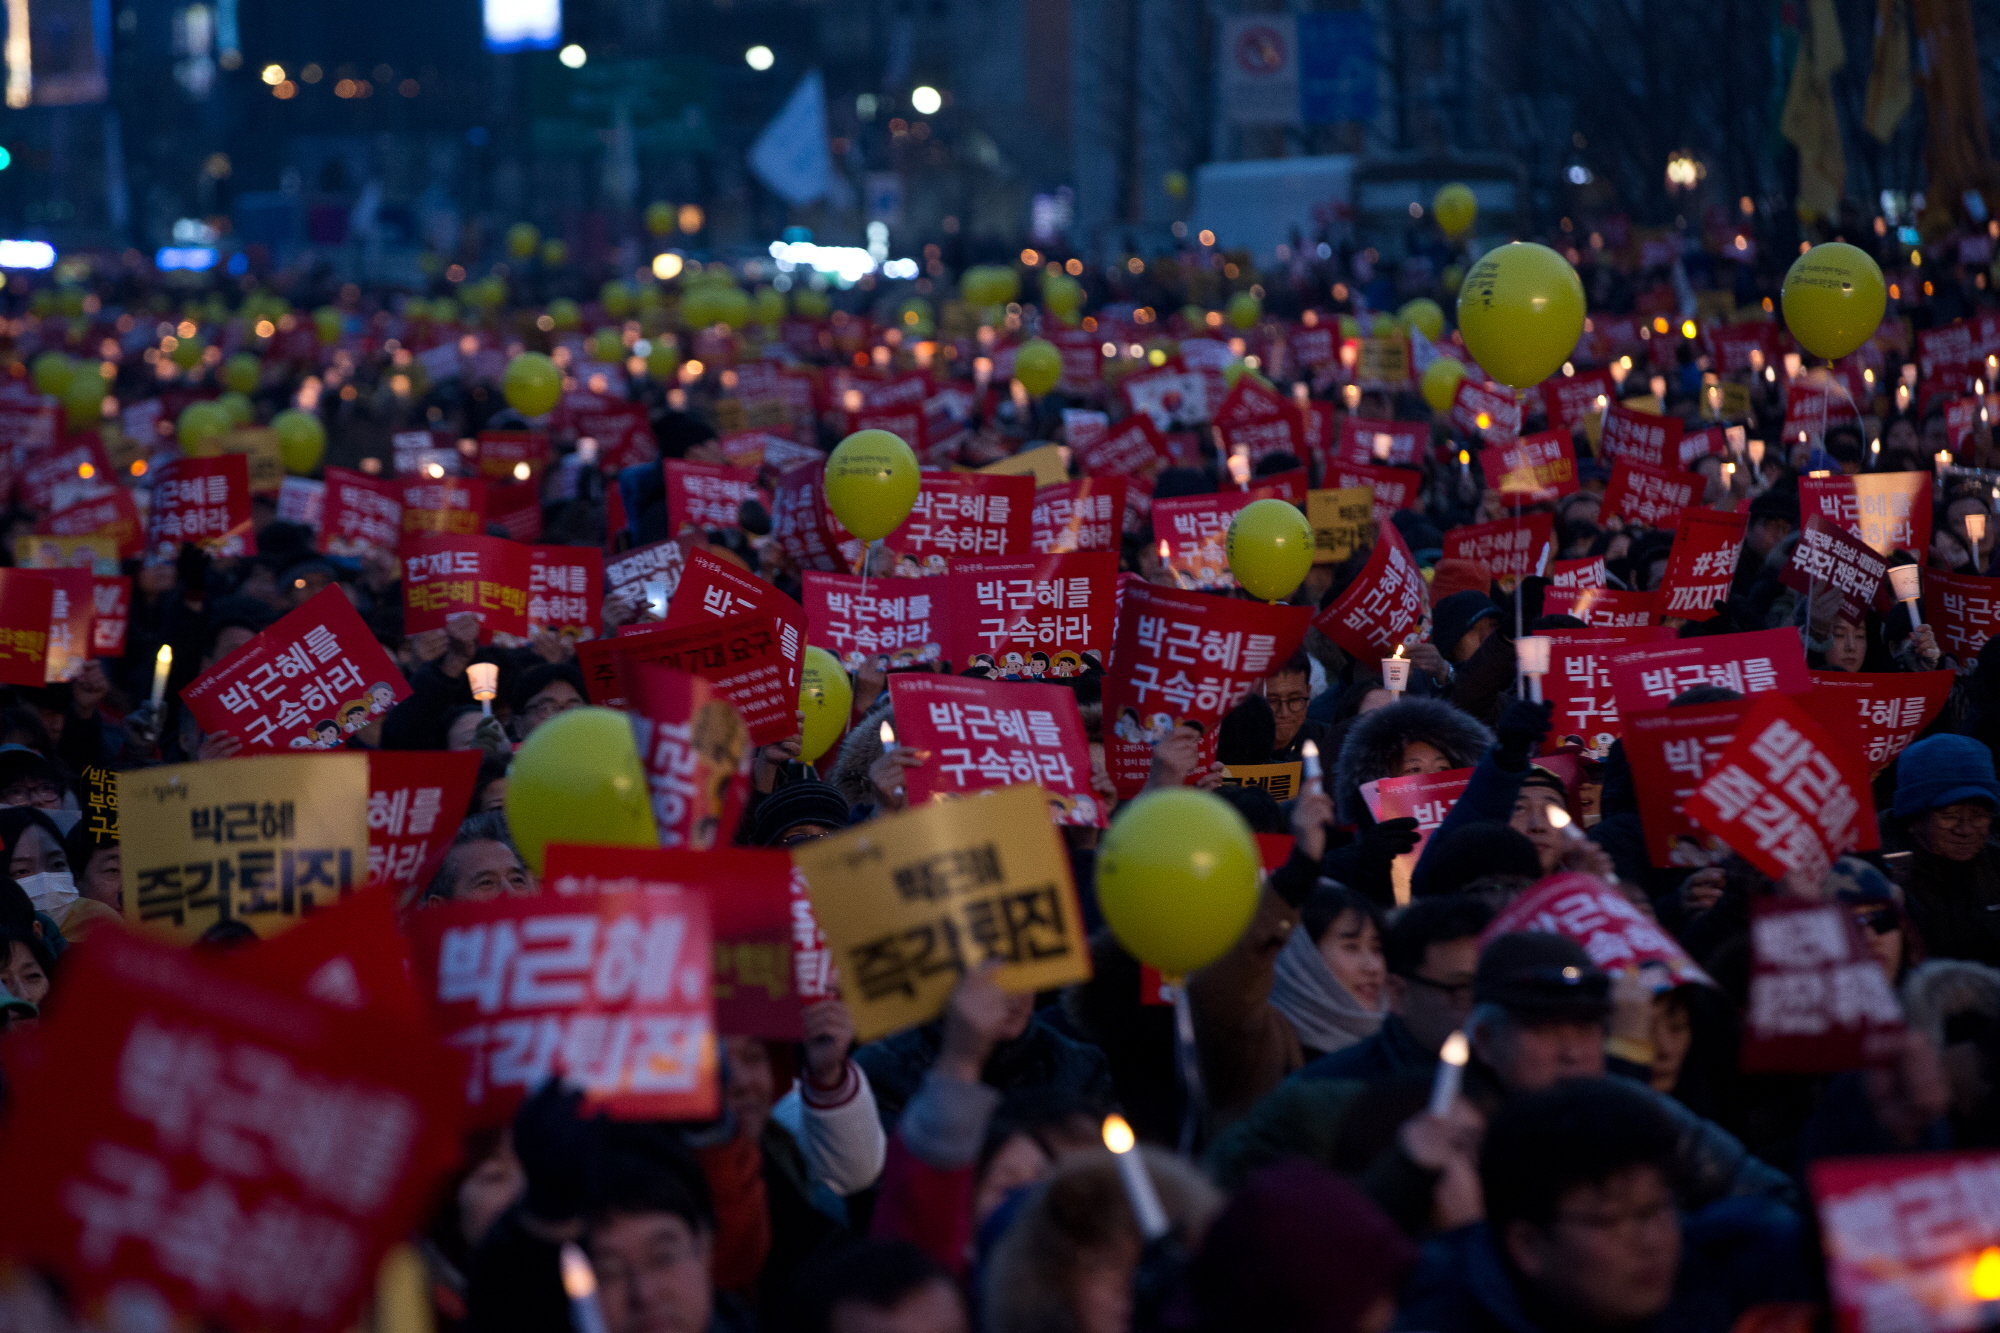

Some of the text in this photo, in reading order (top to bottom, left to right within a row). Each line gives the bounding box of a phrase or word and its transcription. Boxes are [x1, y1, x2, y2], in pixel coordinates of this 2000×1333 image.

[153, 475, 229, 508] 근혜를
[912, 489, 1011, 525] 박근혜를
[1031, 494, 1114, 528] 박근혜를
[905, 519, 1009, 554] 구속하라
[528, 564, 588, 593] 근혜를
[1791, 543, 1837, 582] 무조건
[1831, 560, 1880, 605] 전원구속!
[408, 580, 527, 616] 박근혜 탄핵
[527, 594, 589, 624] 속하라
[826, 590, 932, 623] 박근혜를
[976, 577, 1093, 613] 박근혜를
[826, 620, 931, 652] 구속하라
[978, 613, 1092, 650] 구속하라
[1137, 613, 1278, 674] 박근혜를
[1944, 623, 1991, 652] 구속
[216, 623, 340, 716] 박근혜를
[1638, 656, 1779, 702] 박근혜를
[242, 655, 367, 750] 구속하라
[928, 701, 1061, 748] 박근혜를
[939, 731, 1076, 792] 구속하라
[190, 801, 297, 845] 박근혜
[367, 786, 443, 837] 혜를
[892, 843, 1005, 901] 박근혜
[848, 883, 1068, 1000] 즉각퇴진
[447, 1013, 707, 1106] 각퇴진
